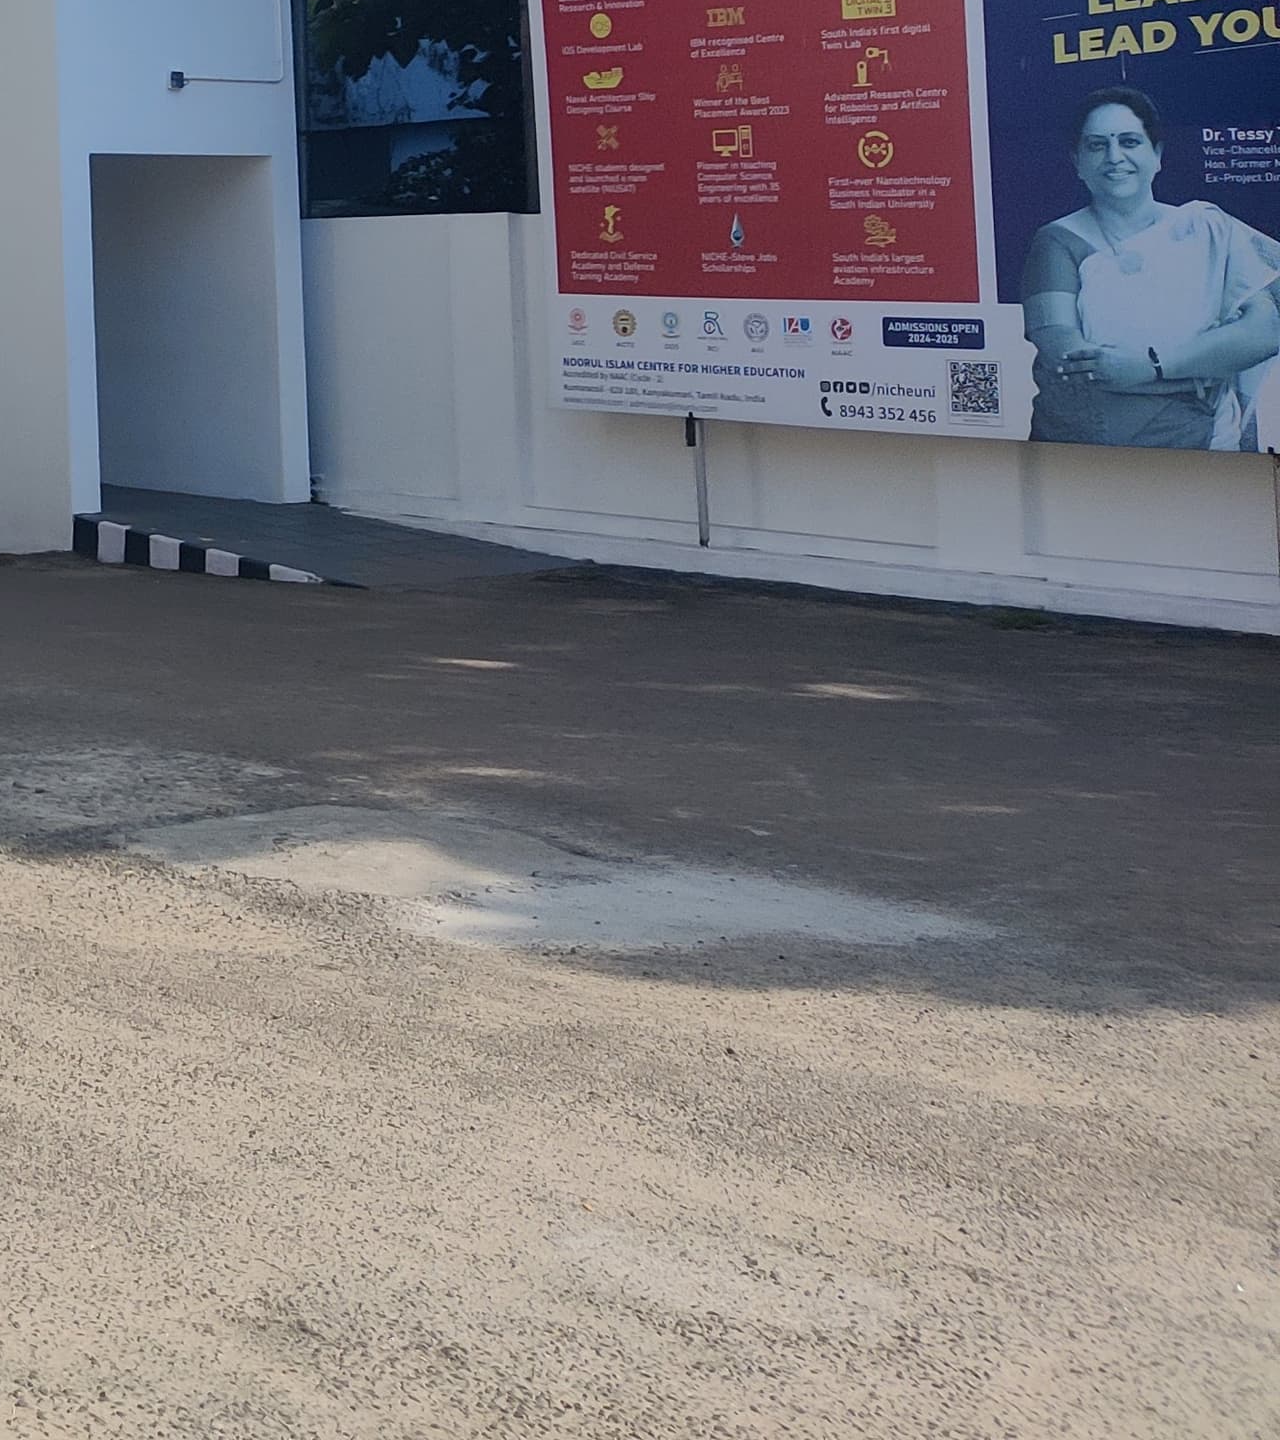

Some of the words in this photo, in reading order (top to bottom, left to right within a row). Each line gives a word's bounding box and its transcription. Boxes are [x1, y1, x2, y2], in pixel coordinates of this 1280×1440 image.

[707, 7, 745, 27] IBM
[857, 6, 883, 16] TWIN
[820, 29, 847, 39] South
[880, 24, 900, 35] first
[844, 39, 861, 49] Lab
[1053, 20, 1177, 64] LEAD
[915, 88, 948, 98] Centre
[824, 104, 838, 113] for
[840, 102, 879, 112] Robotics
[1202, 128, 1225, 141] Dr.
[1227, 127, 1274, 143] Tessy
[833, 275, 876, 288] Academy
[887, 321, 949, 334] ADMISSIONS
[951, 323, 979, 335] OPEN
[908, 333, 959, 345] 2024-2025
[563, 357, 603, 369] NOORUL
[605, 359, 635, 370] ISLAM
[637, 361, 675, 372] CENTRE
[678, 363, 699, 374] FOR
[701, 364, 741, 376] HIGHER
[743, 366, 806, 379] EDUCATION
[871, 382, 936, 398] /nicheuni
[840, 405, 874, 420] 8943
[879, 407, 905, 422] 352
[909, 409, 937, 423] 456
